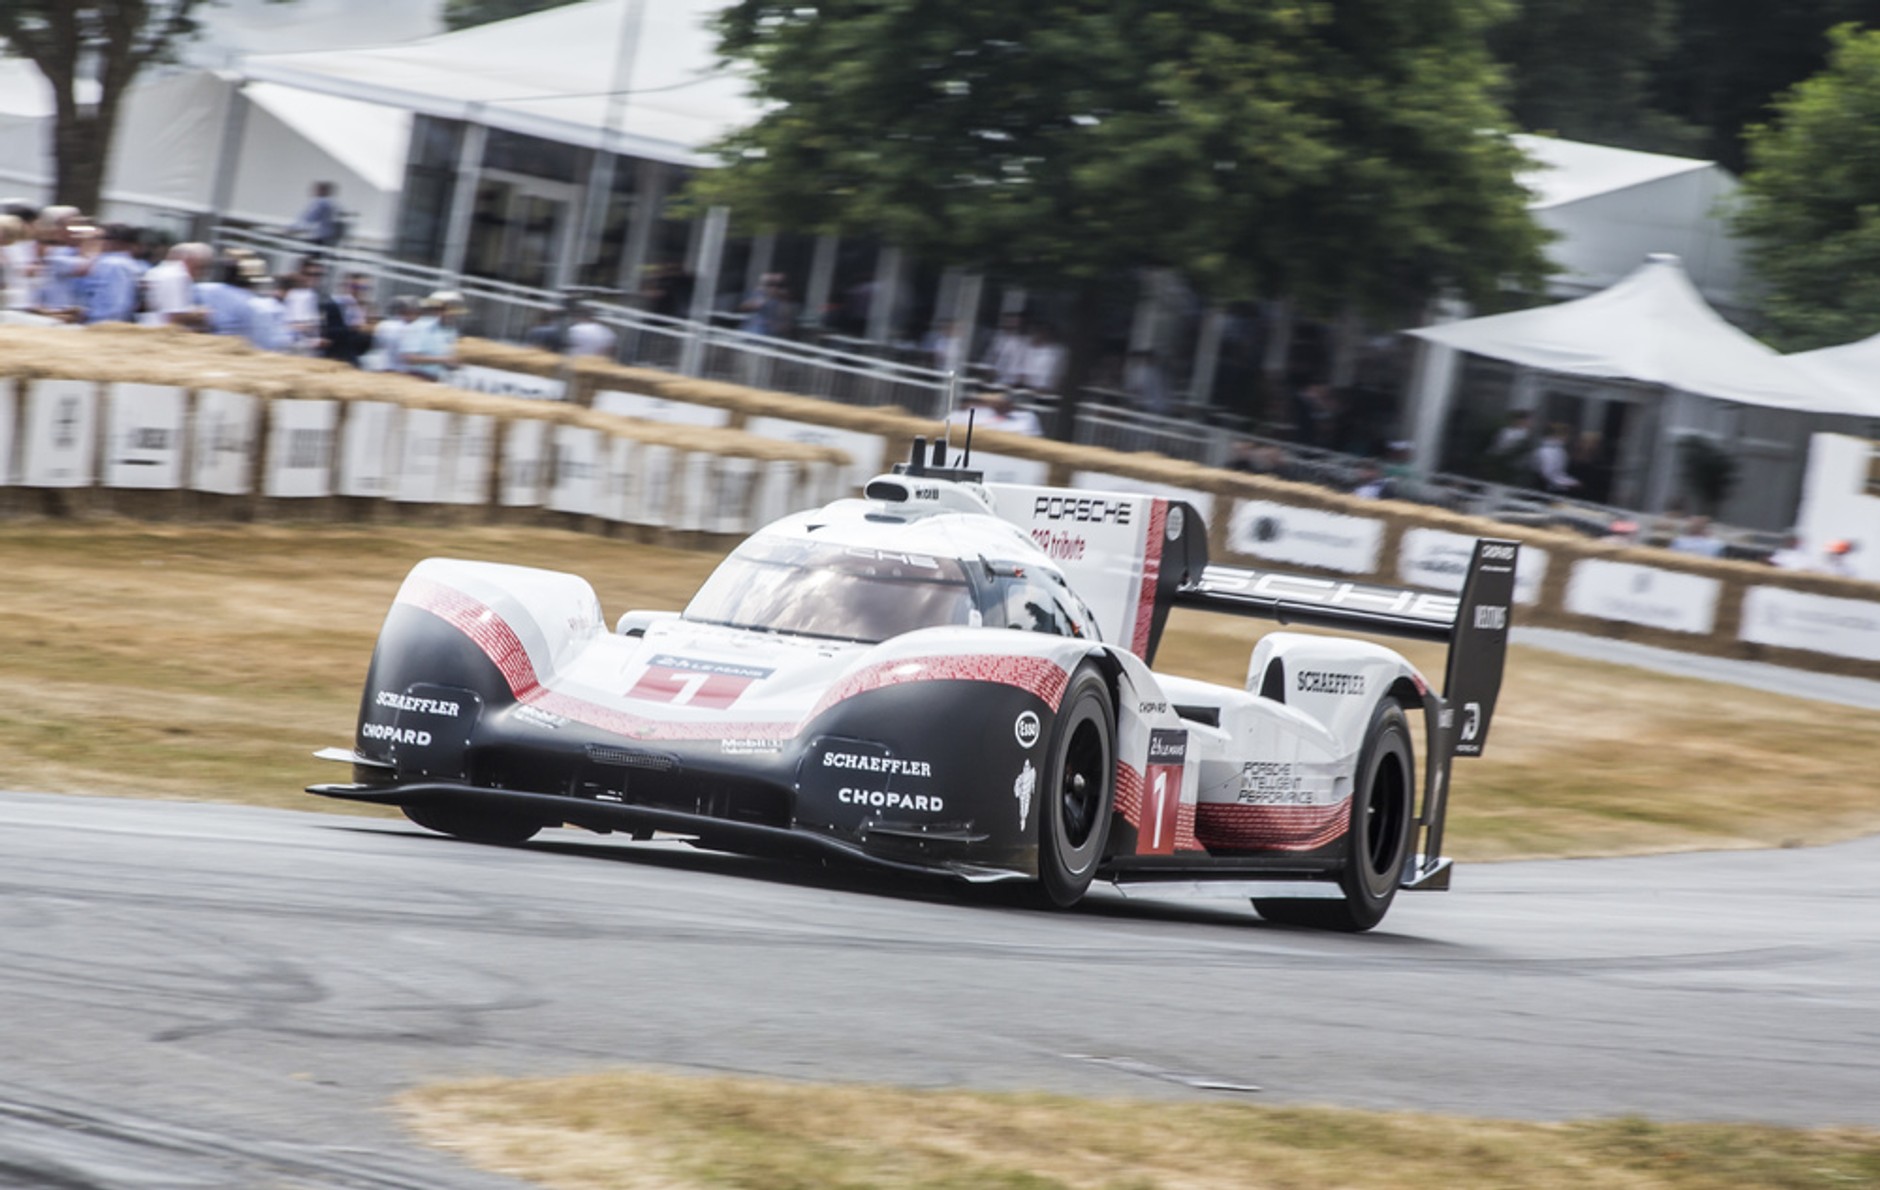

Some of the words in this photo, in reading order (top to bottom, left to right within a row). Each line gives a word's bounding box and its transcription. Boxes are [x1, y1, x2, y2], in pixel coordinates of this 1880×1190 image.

[1033, 497, 1132, 525] PORSCHE
[1049, 530, 1086, 560] tribute
[670, 672, 710, 705] 1
[1298, 671, 1365, 695] SCHAEFFLER
[376, 690, 460, 717] SCHAEFFLER
[362, 722, 432, 746] CHOPARD
[823, 752, 932, 778] SCHAEFFLER
[1243, 761, 1292, 776] PORSCHE
[1241, 776, 1303, 790] INTELLIGENT
[838, 787, 944, 812] CHOPARD
[1237, 789, 1314, 804] PERFORMANCE
[1153, 771, 1167, 849] 1
